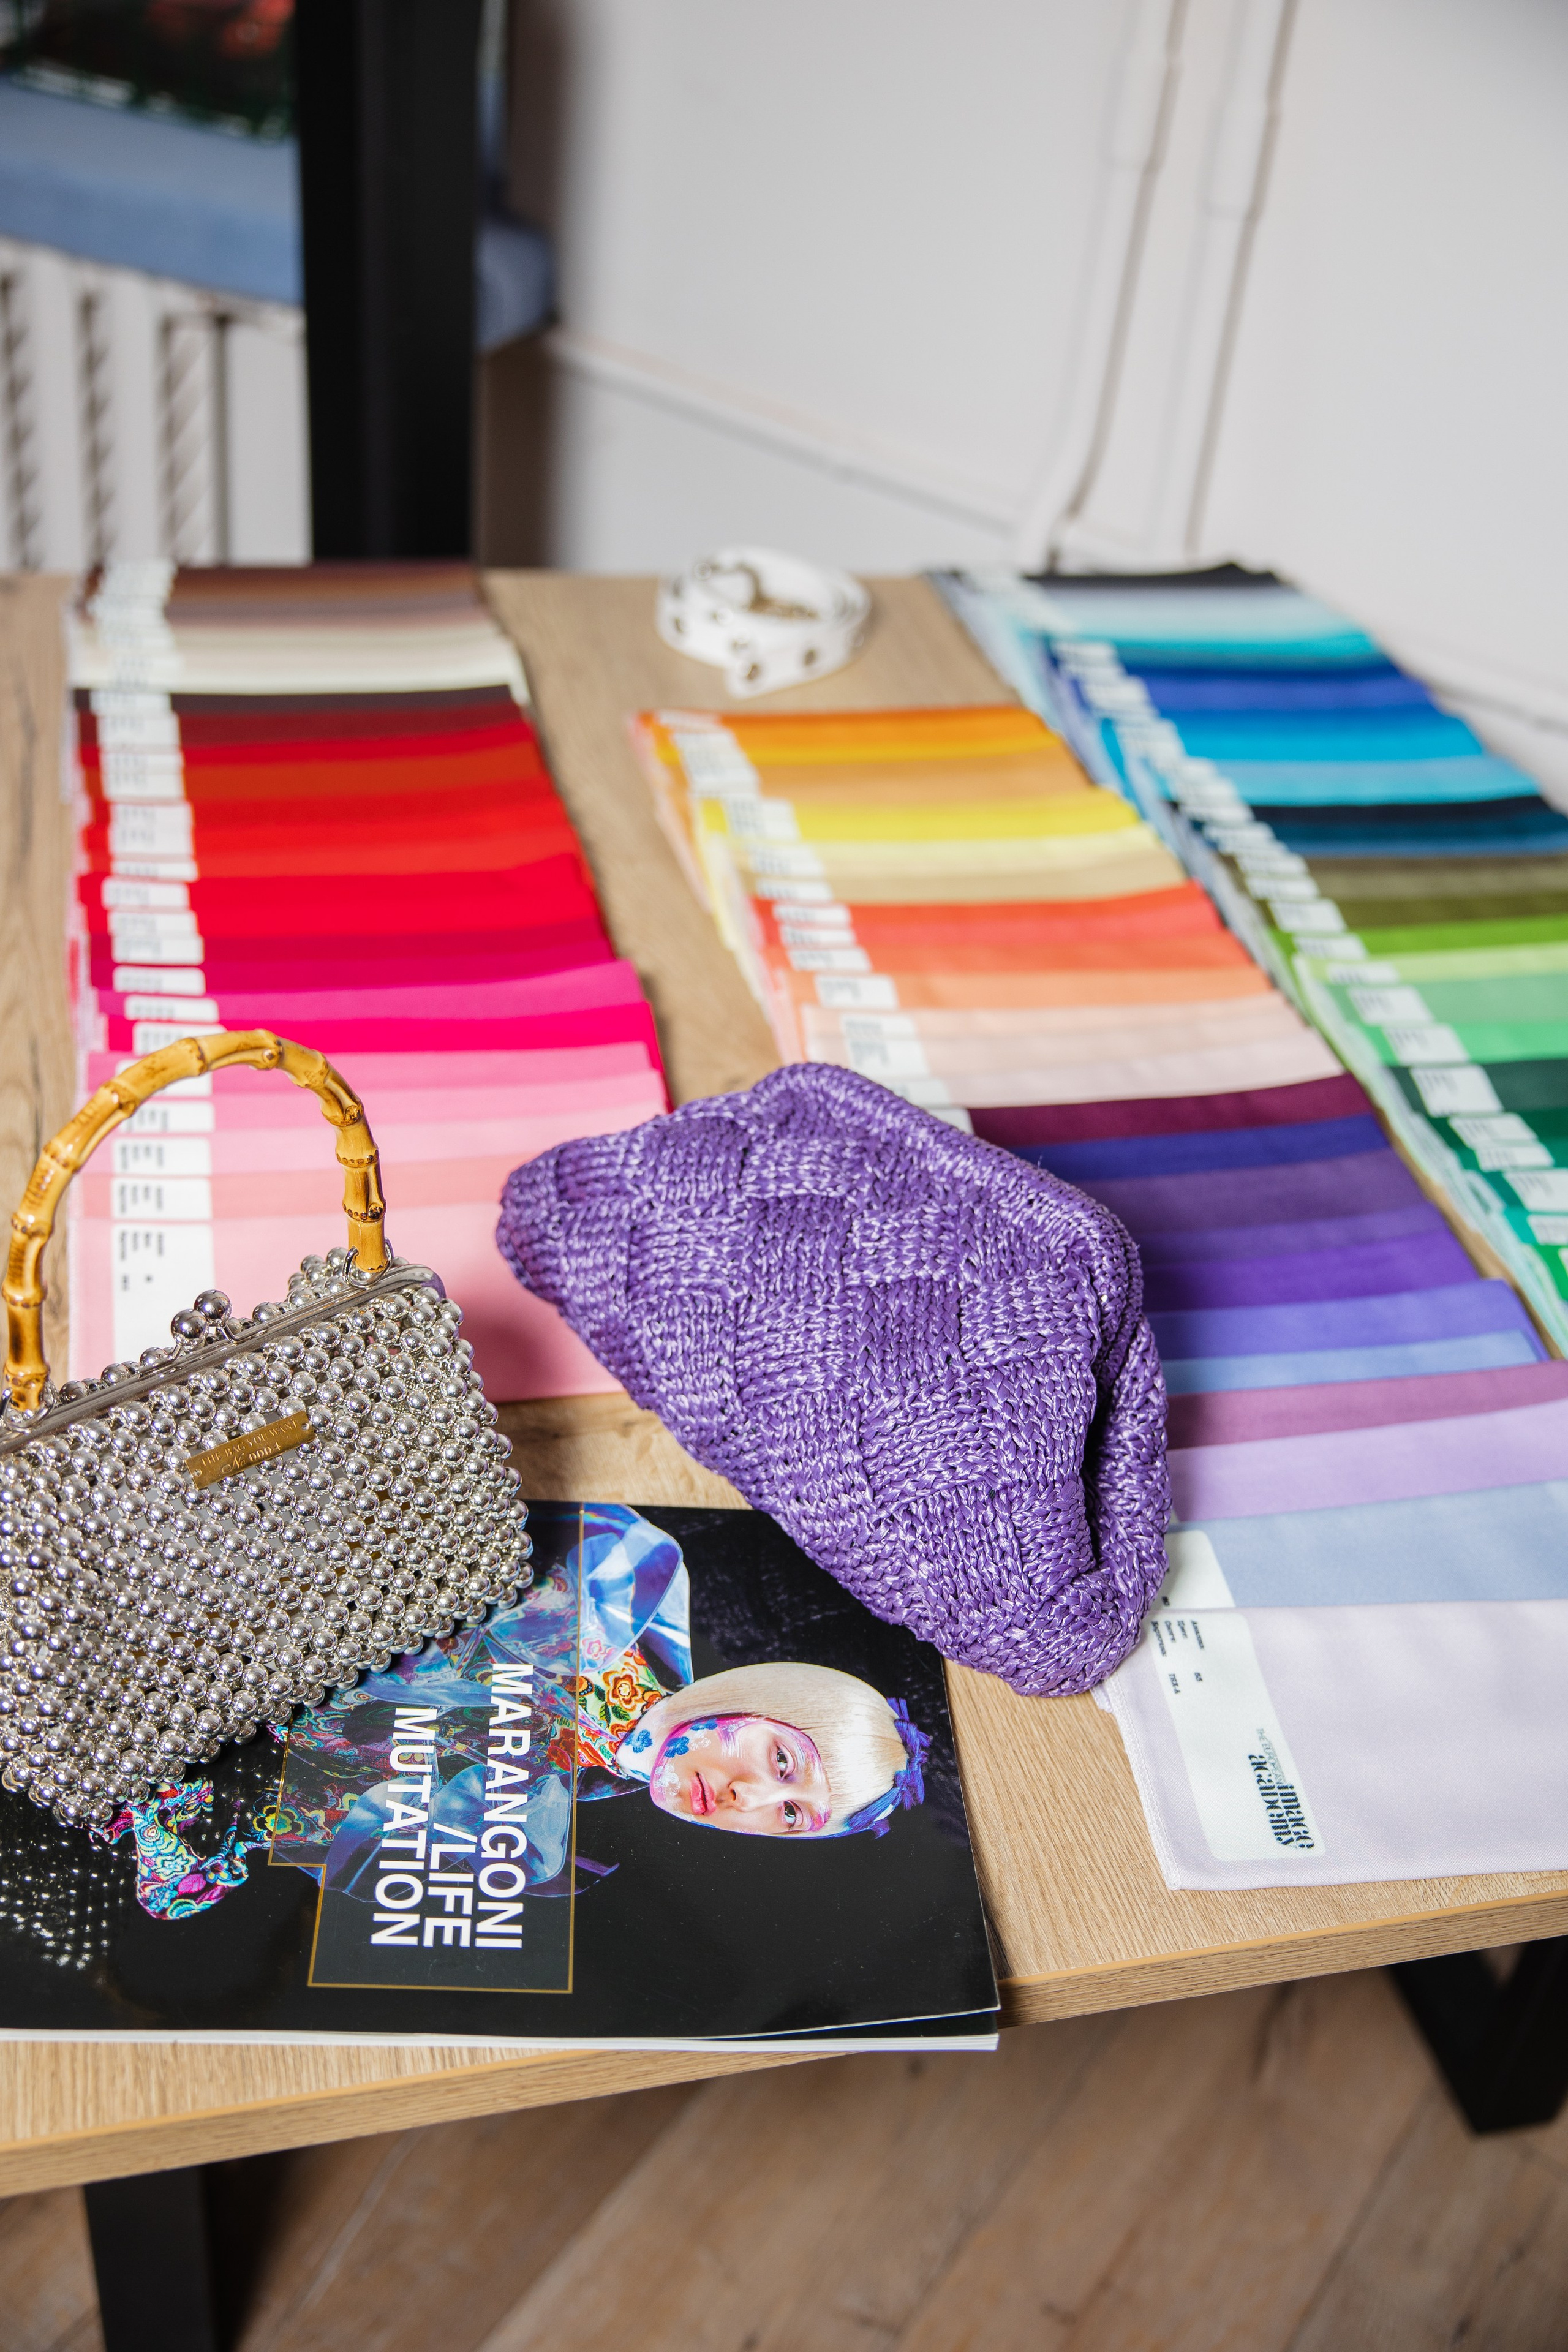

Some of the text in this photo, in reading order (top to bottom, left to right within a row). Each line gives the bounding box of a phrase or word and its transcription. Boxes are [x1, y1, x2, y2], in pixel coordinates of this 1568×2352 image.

[200, 1419, 298, 1467] THE BAG YOU WANT
[248, 1442, 281, 1463] 0004
[370, 1708, 437, 1947] MUTATION
[474, 1663, 534, 1949] MARANGONI
[423, 1822, 478, 1947] /LIFE
